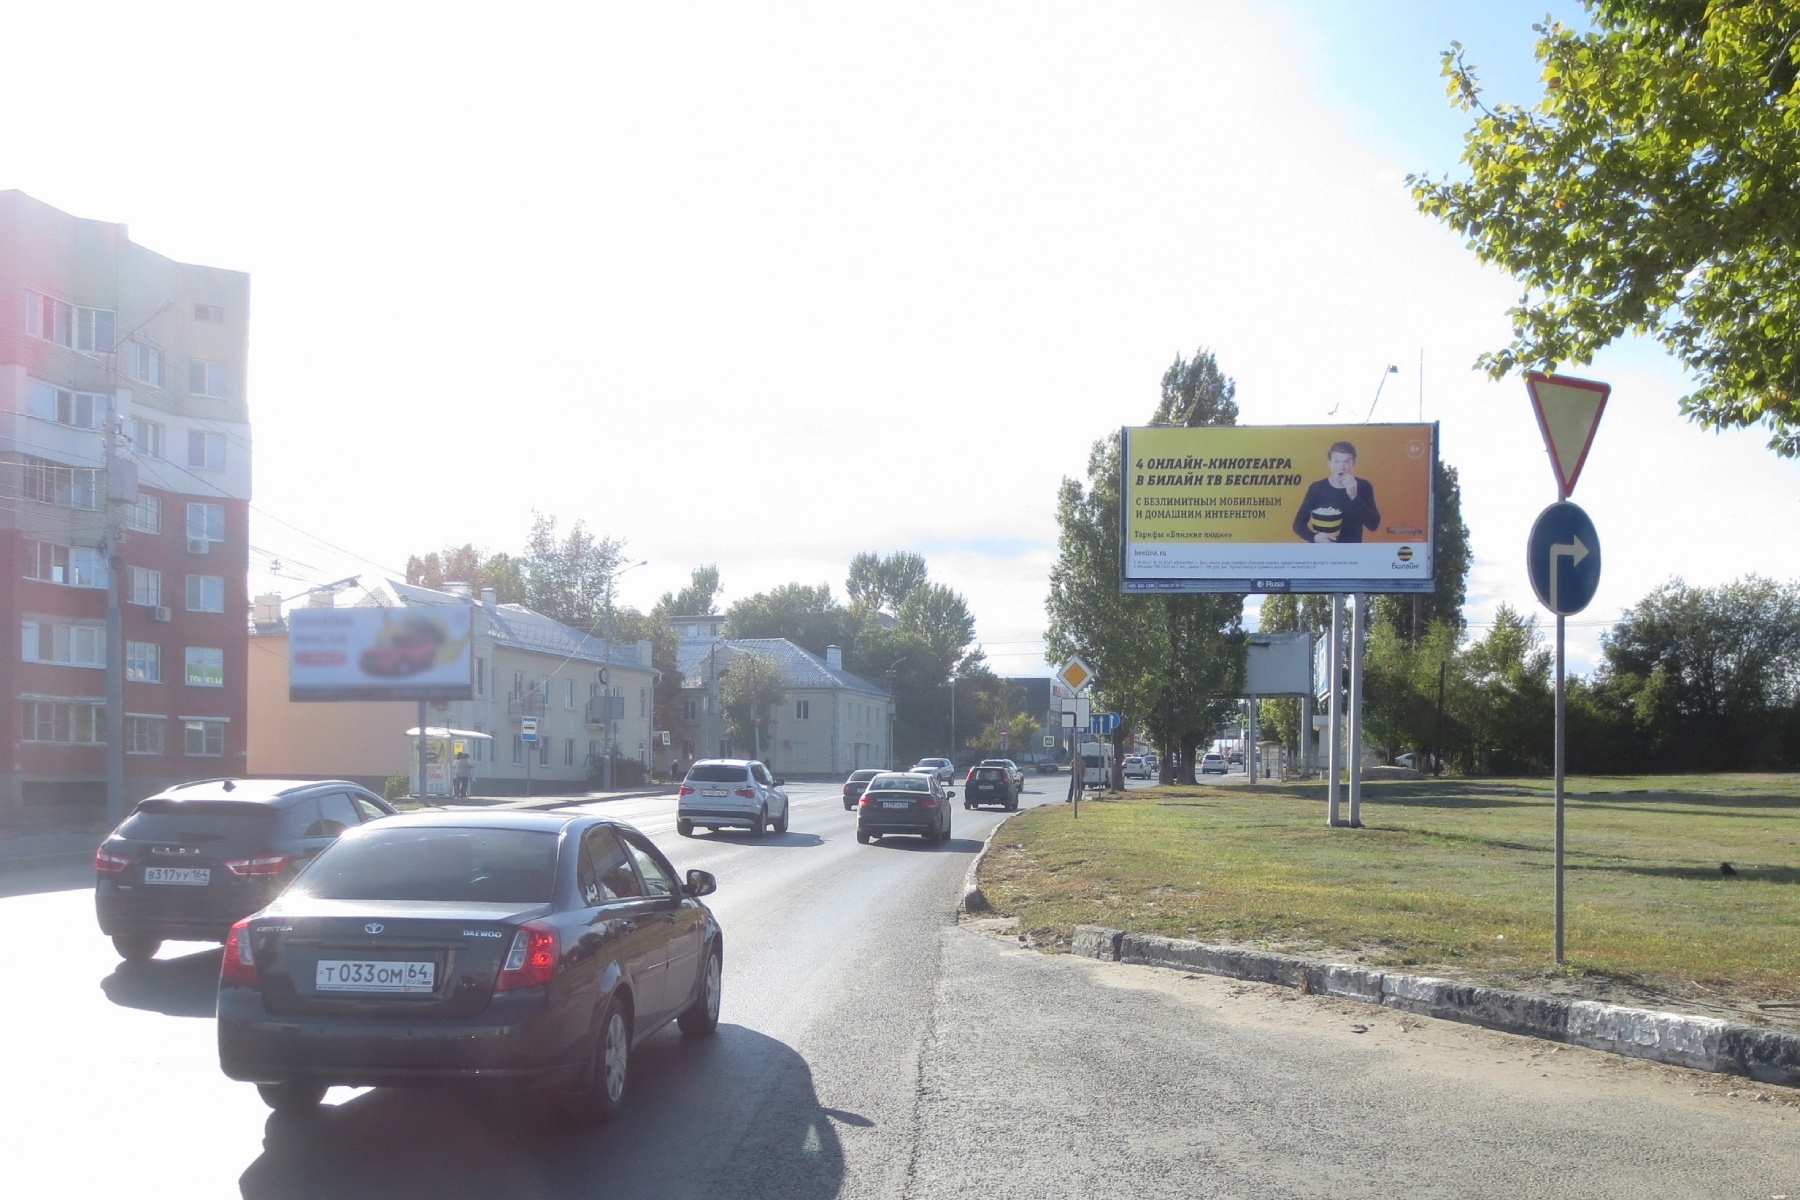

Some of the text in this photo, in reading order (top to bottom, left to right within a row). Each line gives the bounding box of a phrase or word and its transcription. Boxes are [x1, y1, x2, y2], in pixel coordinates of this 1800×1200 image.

[1135, 455, 1292, 470] 4 ОНЛАЙН-КИНОТЕАТРА
[1135, 472, 1302, 486] В БИЛАЙН ТВ БЕСПЛАТНО
[1135, 497, 1282, 506] С БЕЗЛИМИТНЫМ МОБИЛЬНЫМ
[1135, 509, 1266, 520] И ДОМАШНИМ ИНТЕРНЕТОМ
[1134, 530, 1164, 539] Тарифы
[1165, 530, 1203, 538] «Близкие
[1134, 549, 1167, 557] beeline.ru
[1391, 562, 1419, 570] Билайн
[1265, 580, 1285, 588] Russ
[152, 847, 200, 855] LADA
[191, 870, 209, 879] 164
[463, 929, 502, 938] DAEWOO
[407, 964, 428, 979] 64
